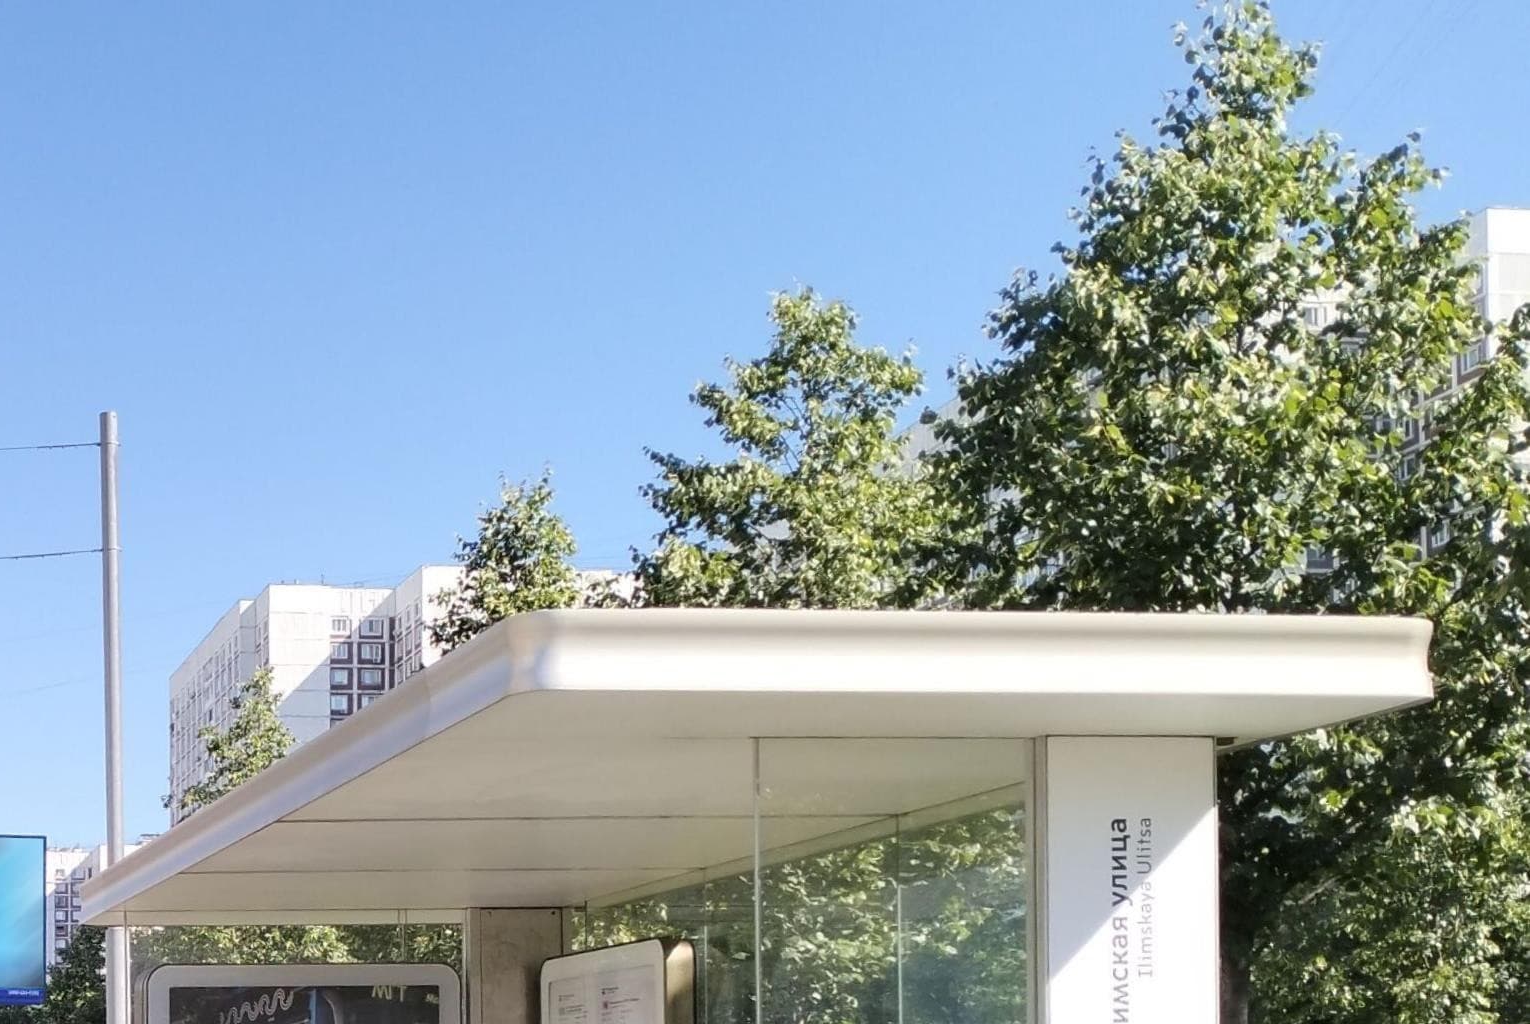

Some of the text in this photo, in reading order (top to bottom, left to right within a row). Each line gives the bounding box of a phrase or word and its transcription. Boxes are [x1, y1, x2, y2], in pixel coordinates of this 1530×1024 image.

[1111, 818, 1133, 907] улица
[1137, 818, 1155, 978] Ilimskaya Ulitsa
